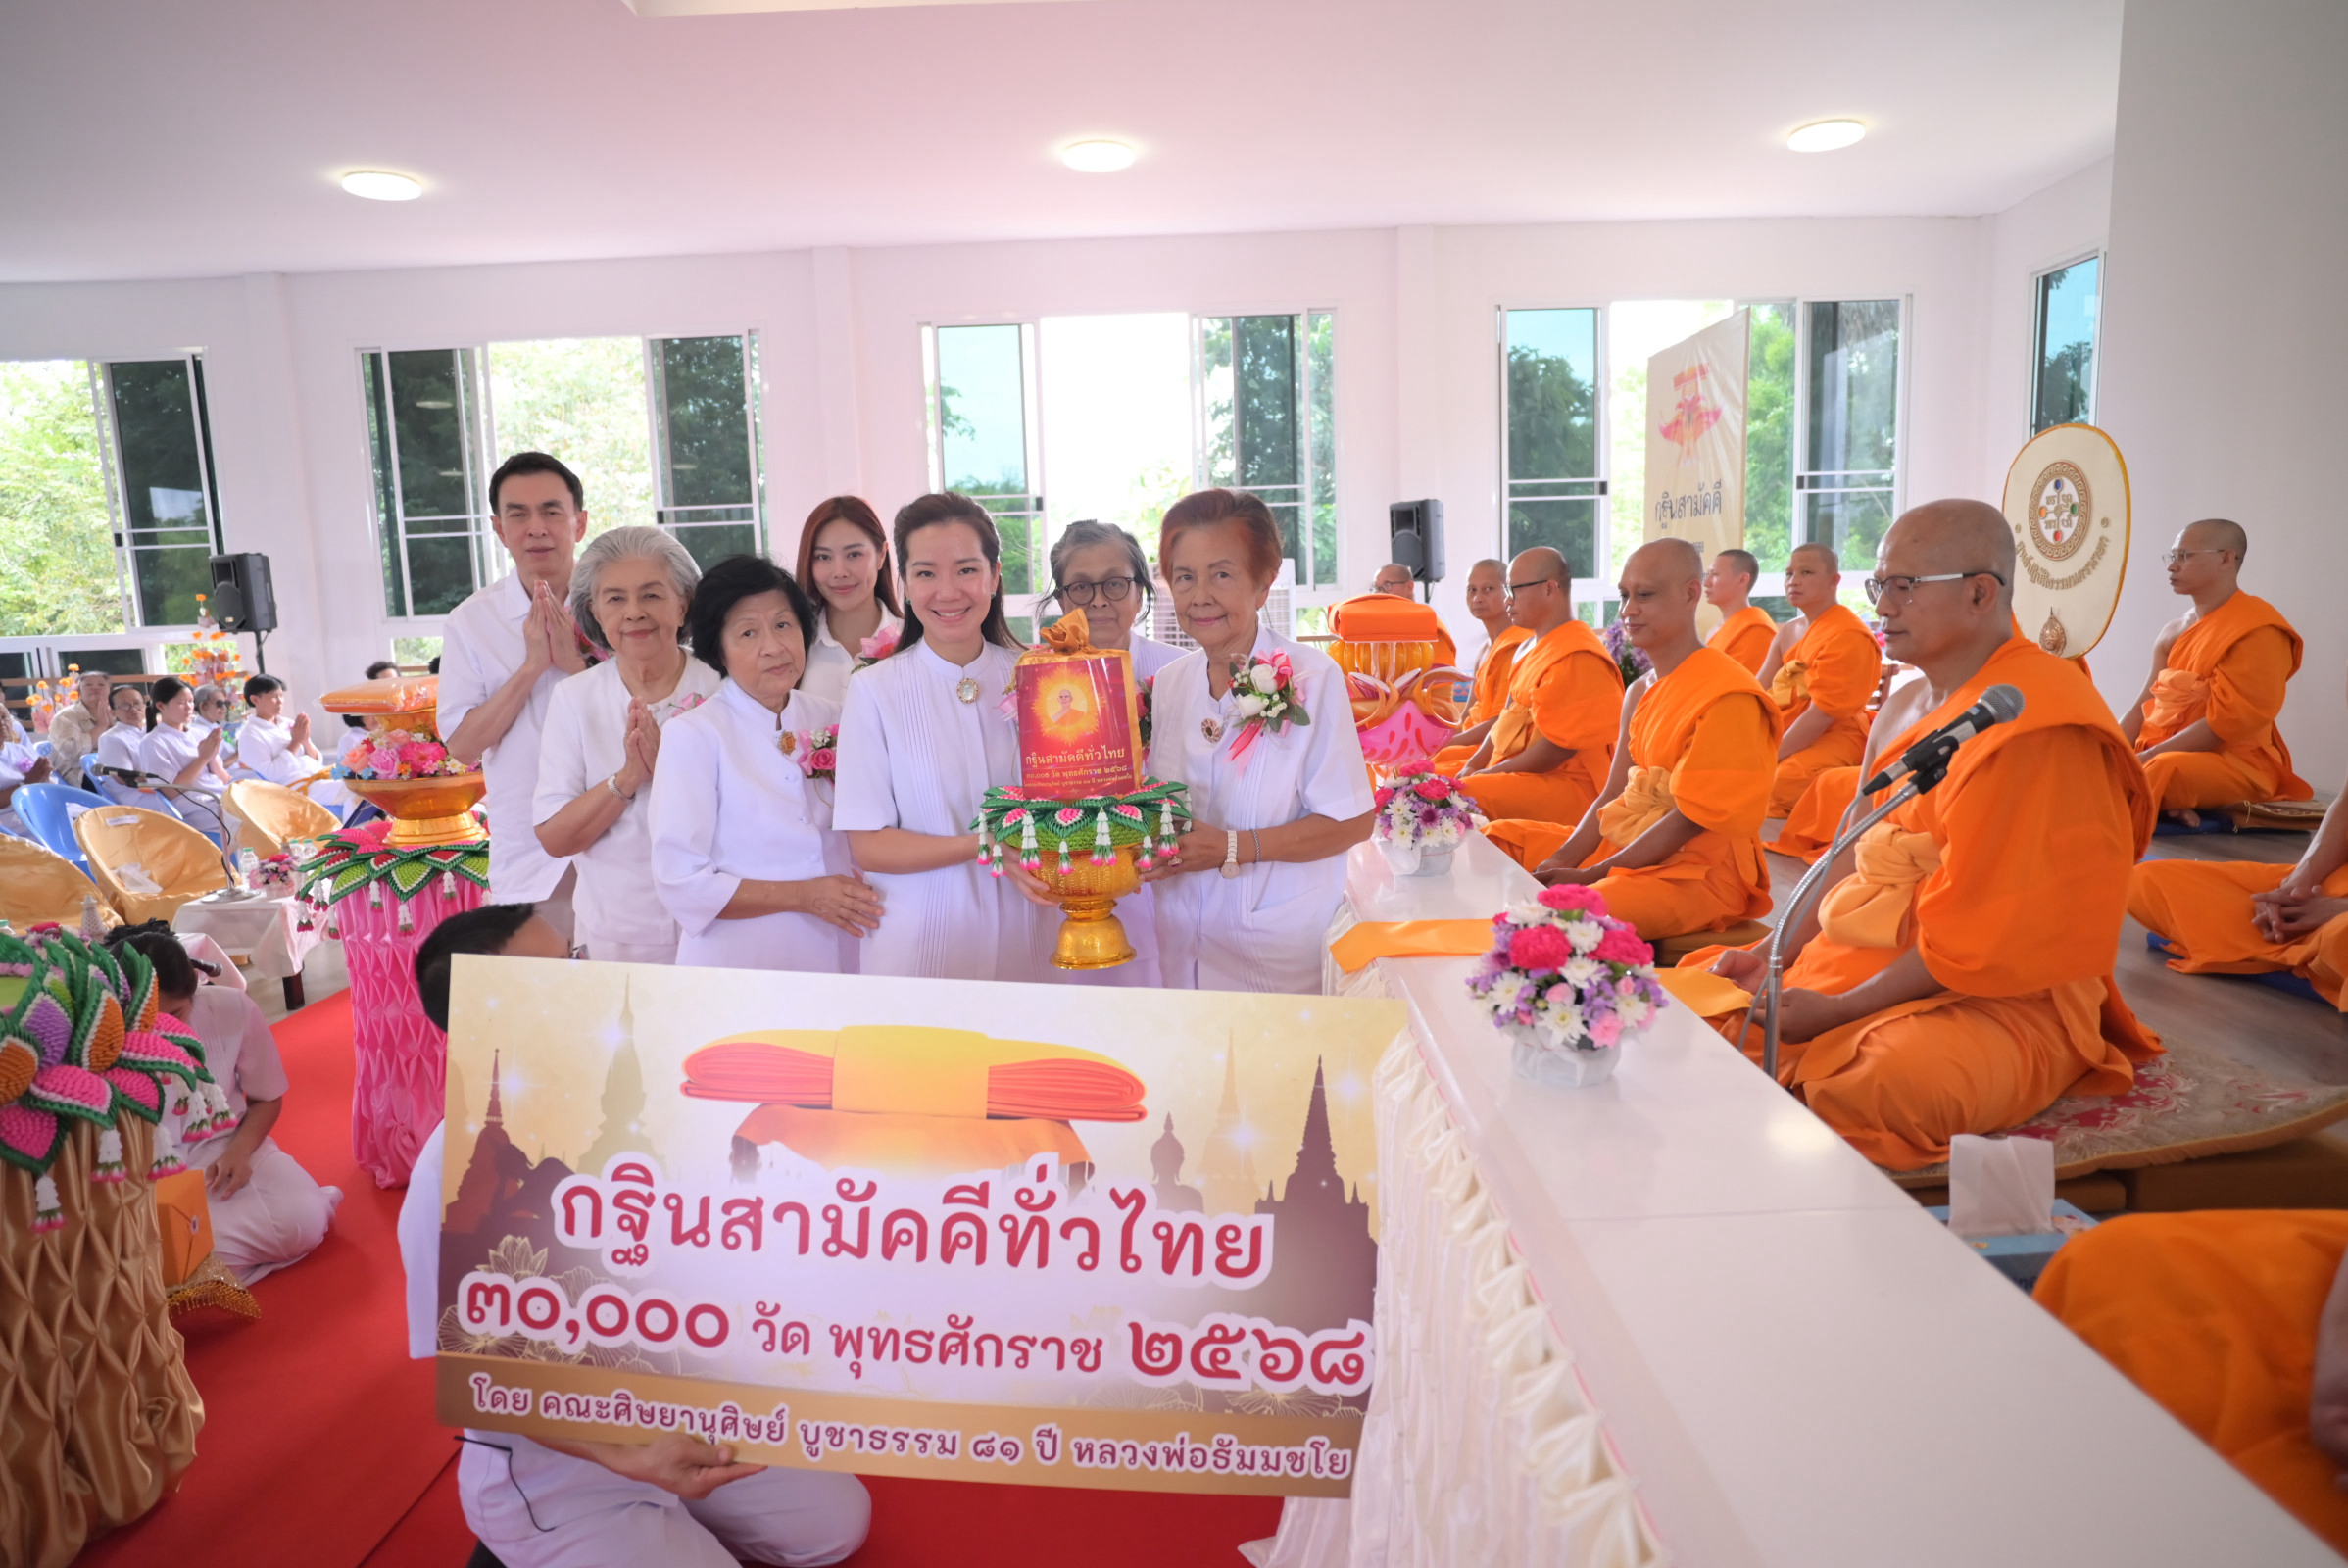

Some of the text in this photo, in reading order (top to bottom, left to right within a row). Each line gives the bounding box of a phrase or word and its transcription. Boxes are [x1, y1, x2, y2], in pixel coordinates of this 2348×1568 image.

[1655, 478, 1722, 529] กฐินสามัคคี
[1025, 745, 1124, 767] กฐินสามัคคีทั่วไทย
[562, 1162, 1262, 1279] กฐินสามัคคีทั่วไทย
[466, 1281, 1366, 1386] ๓๐,๐๐๐ วัด พุทธศักราช ๒๕๖๘
[473, 1376, 1348, 1476] โดย คณะศิษยานุศิษย์ บูชาธรรม ๘๑ ปี หลวงพ่อธัมมชโย
